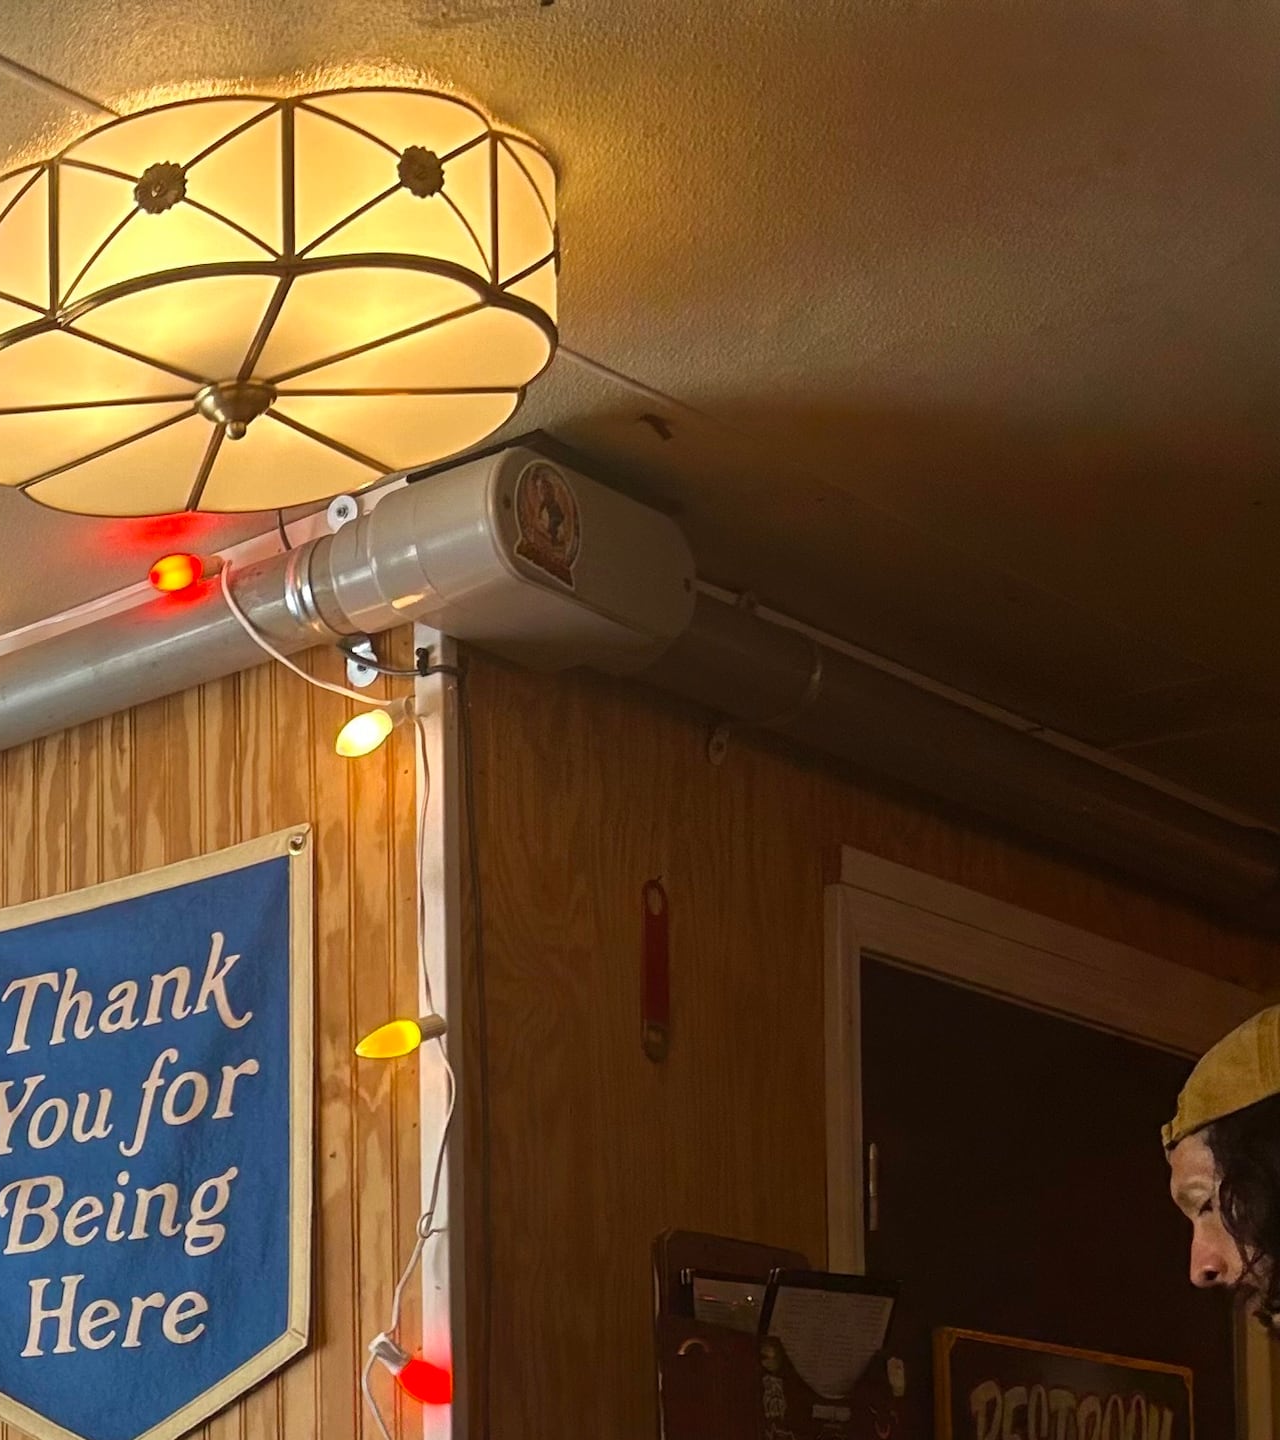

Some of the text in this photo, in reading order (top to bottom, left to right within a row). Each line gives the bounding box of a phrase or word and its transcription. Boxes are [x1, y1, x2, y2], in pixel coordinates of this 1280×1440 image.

[1, 931, 254, 1055] Thank
[119, 1047, 260, 1158] for
[19, 1273, 209, 1358] Here
